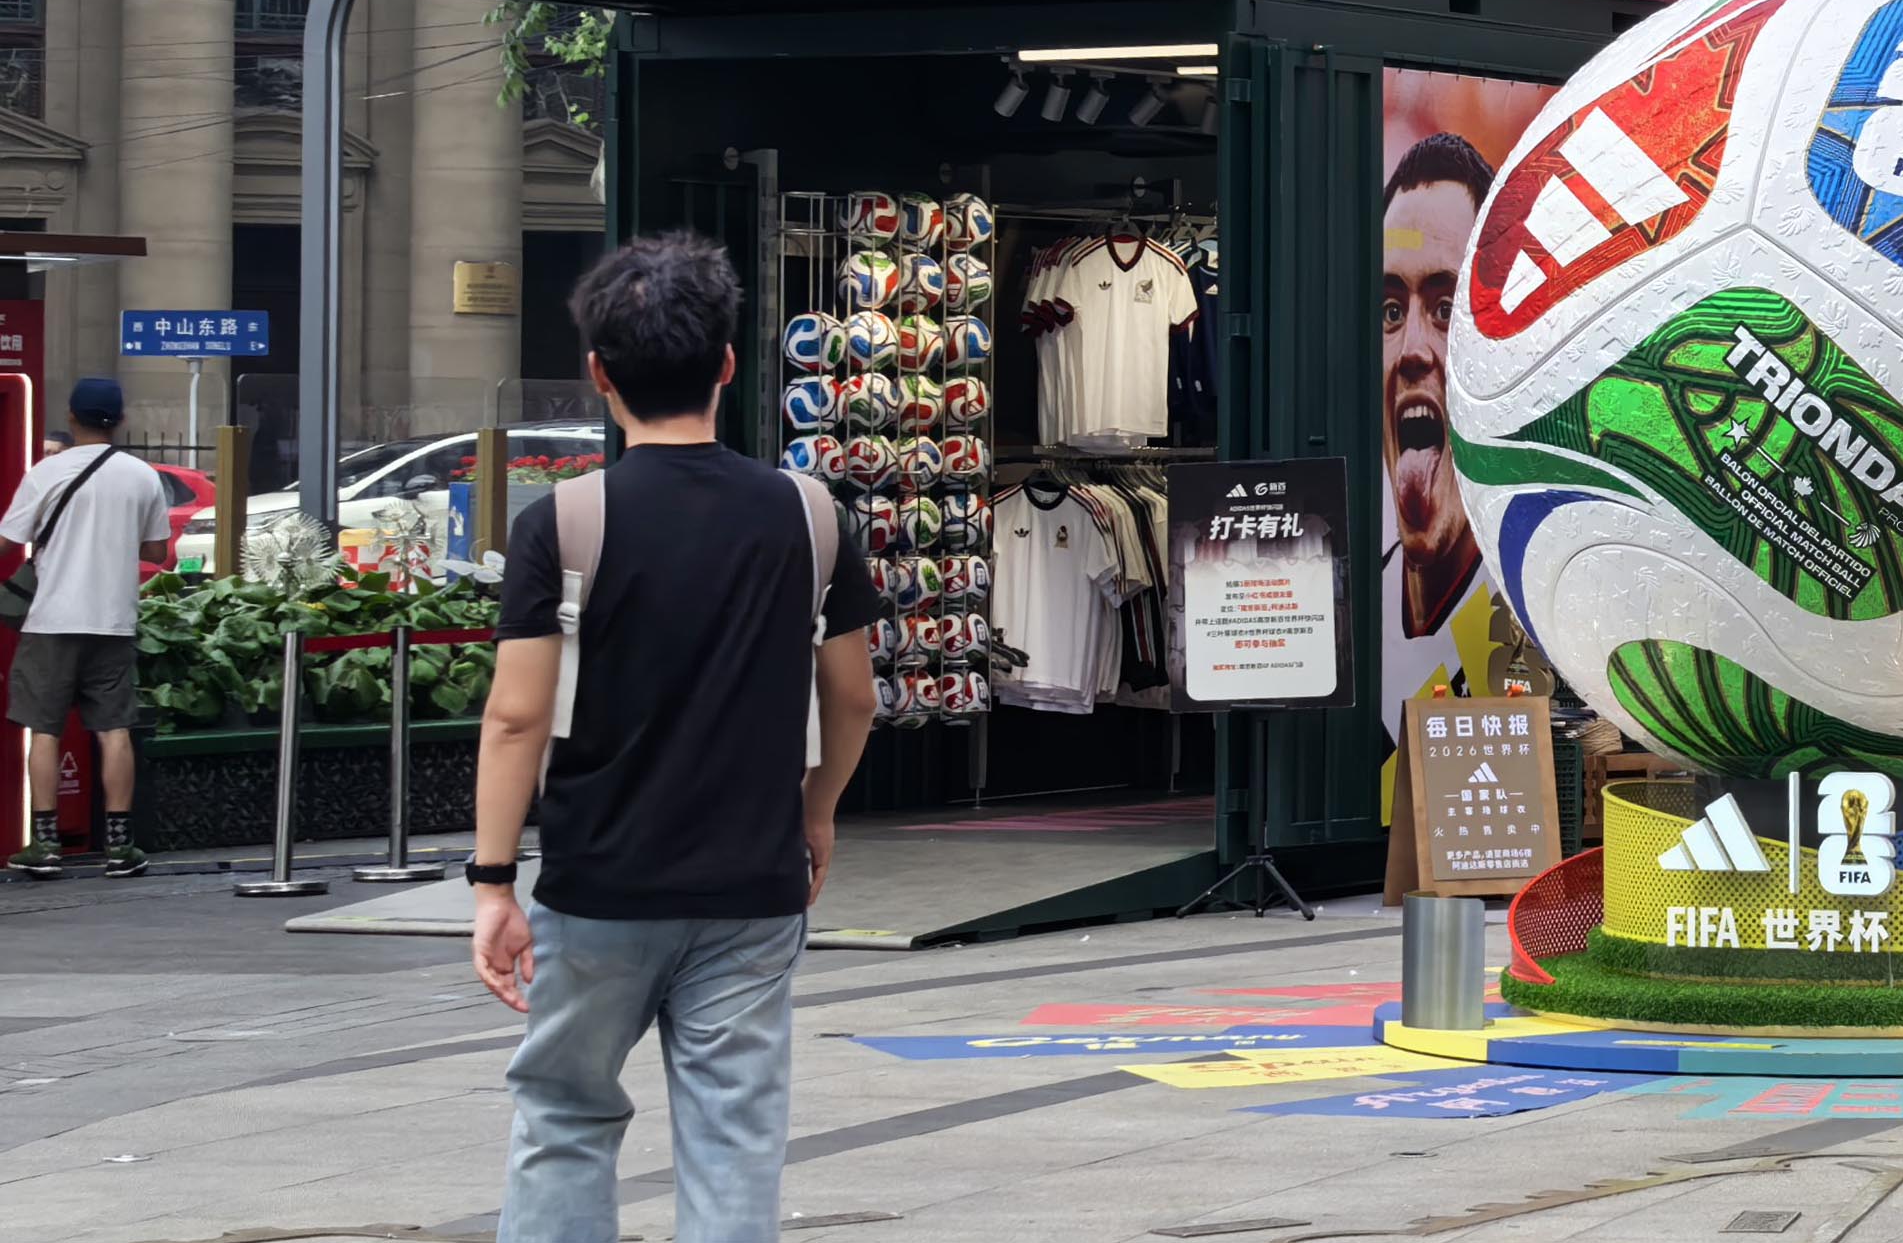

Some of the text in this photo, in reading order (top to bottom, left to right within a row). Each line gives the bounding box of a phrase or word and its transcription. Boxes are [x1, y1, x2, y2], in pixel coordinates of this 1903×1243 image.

[155, 317, 238, 337] 中山东路
[1209, 512, 1305, 541] 打卡有礼
[1704, 474, 1854, 599] BALLON DE MATCH OFFICIEL
[1740, 489, 1861, 588] OFFICIAL MATCH BALL
[1757, 485, 1800, 527] OFICIAL
[1798, 519, 1823, 540] DEL
[1820, 534, 1872, 578] PARTIDO
[1426, 713, 1529, 738] 每日快报
[1429, 743, 1530, 757] 2026世界杯
[1839, 871, 1872, 884] FIFA
[1666, 906, 1890, 954] FIFA 世界杯
